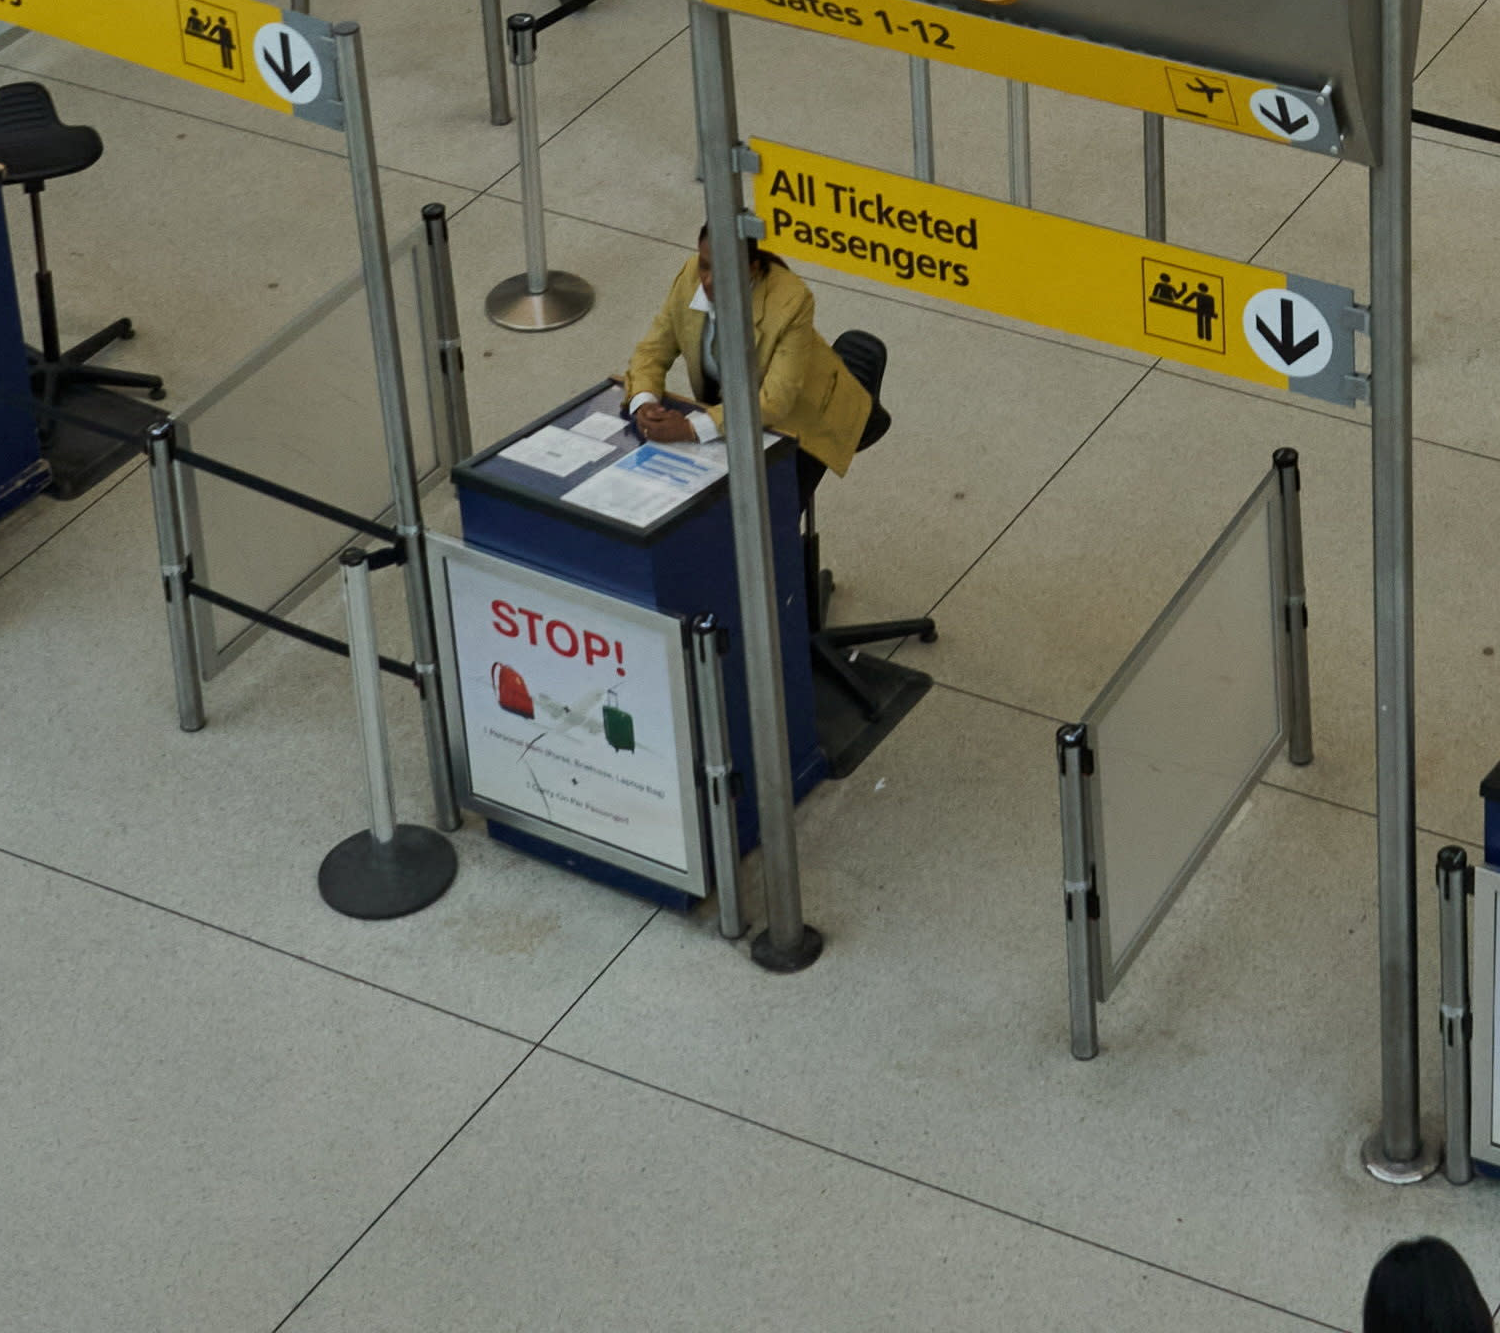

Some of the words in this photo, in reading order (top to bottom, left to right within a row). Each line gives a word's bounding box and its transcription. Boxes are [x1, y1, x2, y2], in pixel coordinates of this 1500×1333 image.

[872, 7, 957, 51] 1-12
[768, 168, 816, 208] All
[824, 180, 980, 252] Ticketed
[771, 207, 971, 290] Passengers
[488, 598, 627, 678] STOP!
